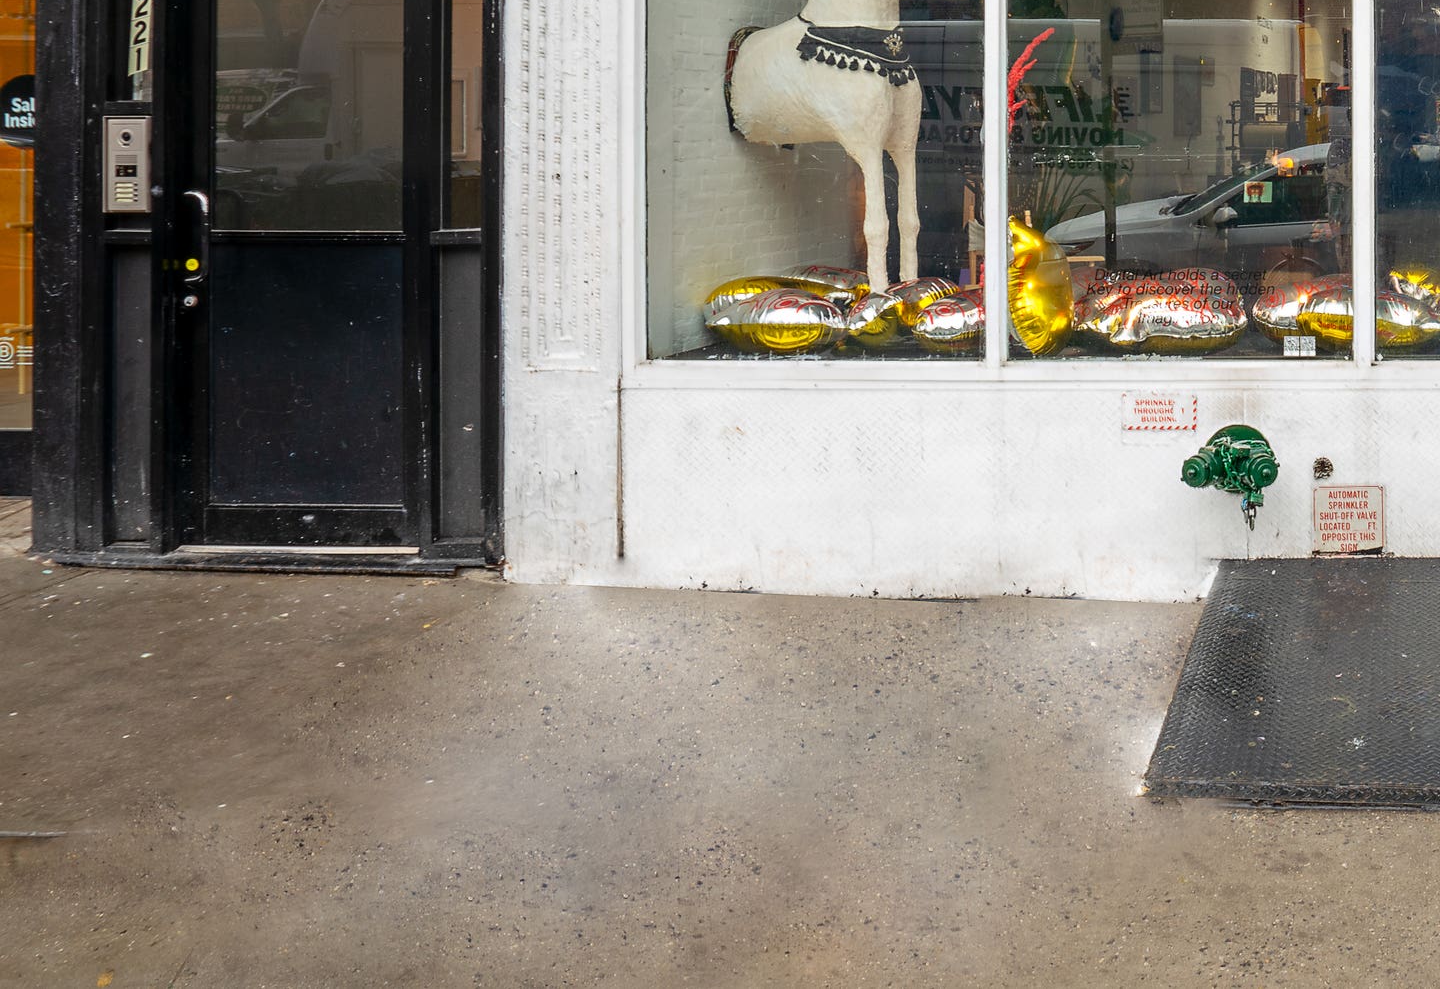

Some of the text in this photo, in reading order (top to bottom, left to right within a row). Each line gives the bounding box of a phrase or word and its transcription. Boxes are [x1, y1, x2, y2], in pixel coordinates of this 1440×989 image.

[4, 112, 36, 128] Insi
[1095, 269, 1266, 283] Digital Art holds a secret
[1086, 282, 1275, 297] Key to discover the hidden
[1194, 298, 1208, 309] of
[1212, 300, 1235, 310] our
[1135, 398, 1175, 406] SPRINKLE
[1328, 490, 1369, 499] AUTOMATIC
[1328, 501, 1369, 509] SPRINKLER
[1319, 511, 1377, 520] SHUT-OFF VALVE
[1319, 522, 1351, 531] LOCATED
[1321, 532, 1376, 542] OPPOSITE THIS
[1340, 543, 1359, 551] SIGN
